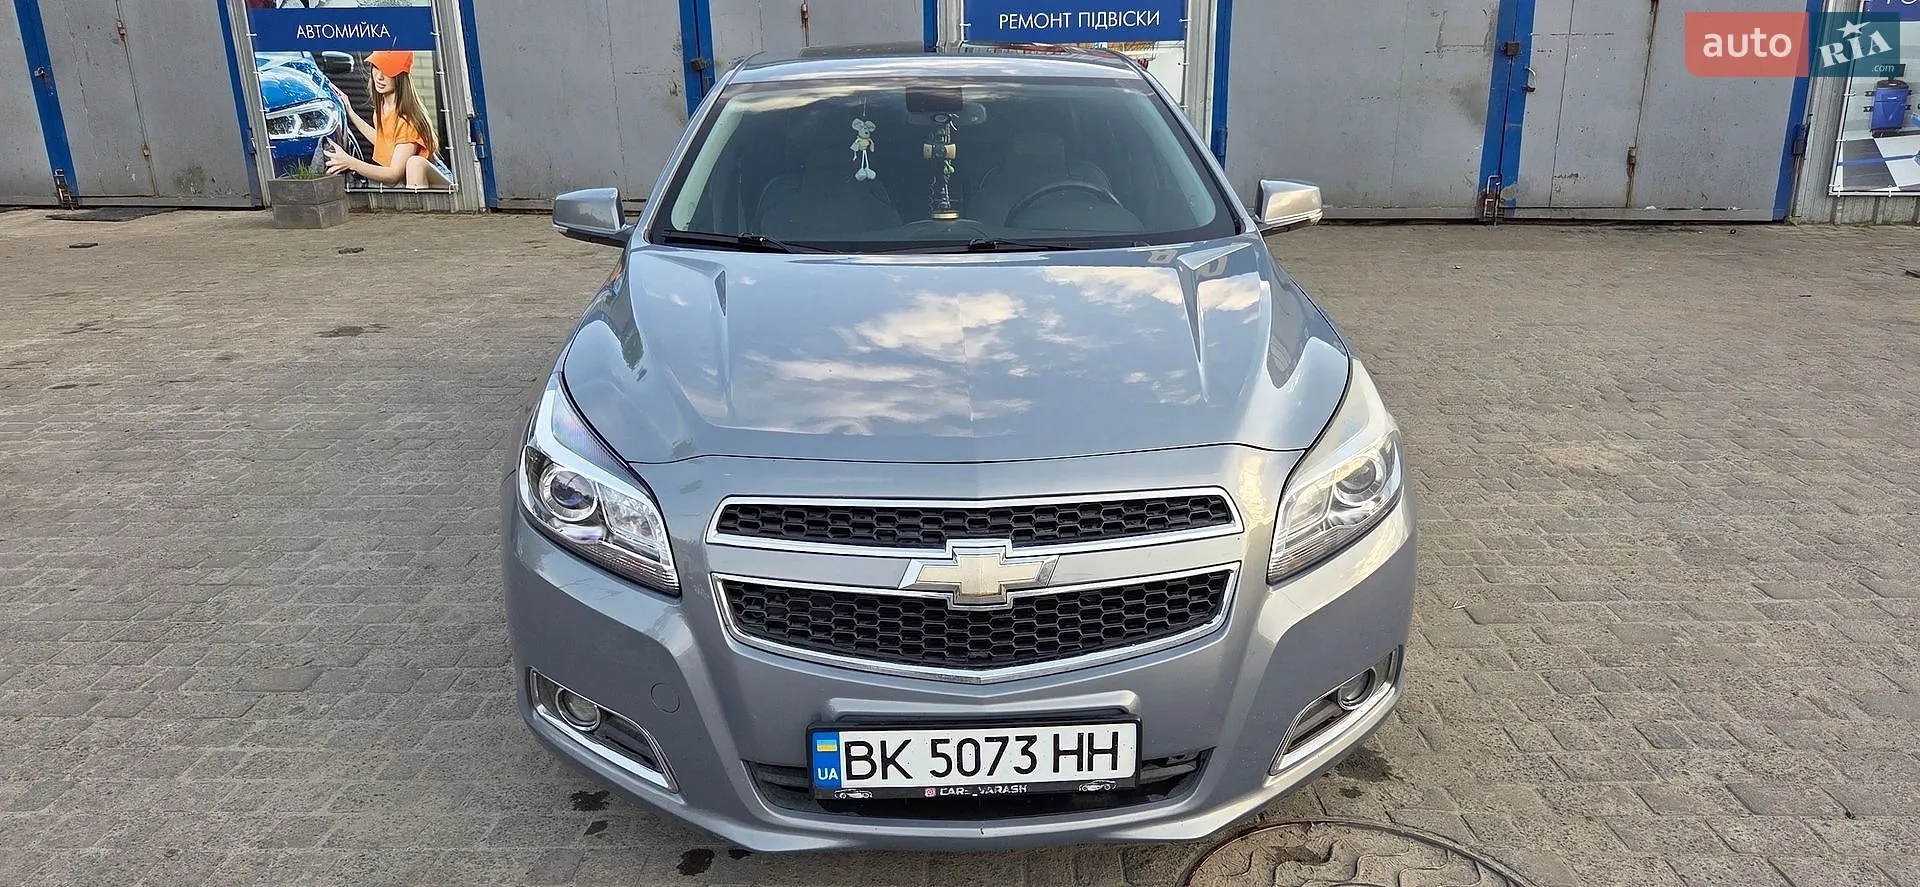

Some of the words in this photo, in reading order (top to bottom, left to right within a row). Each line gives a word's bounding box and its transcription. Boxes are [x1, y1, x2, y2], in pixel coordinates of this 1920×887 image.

[999, 12, 1072, 30] РЕМОНТ
[1077, 10, 1160, 30] ПІДВІСКИ
[296, 21, 391, 39] АВТОМИЙКА
[845, 738, 913, 781] BK
[929, 734, 1038, 778] 5073
[1052, 731, 1119, 774] HH
[817, 767, 839, 781] UA
